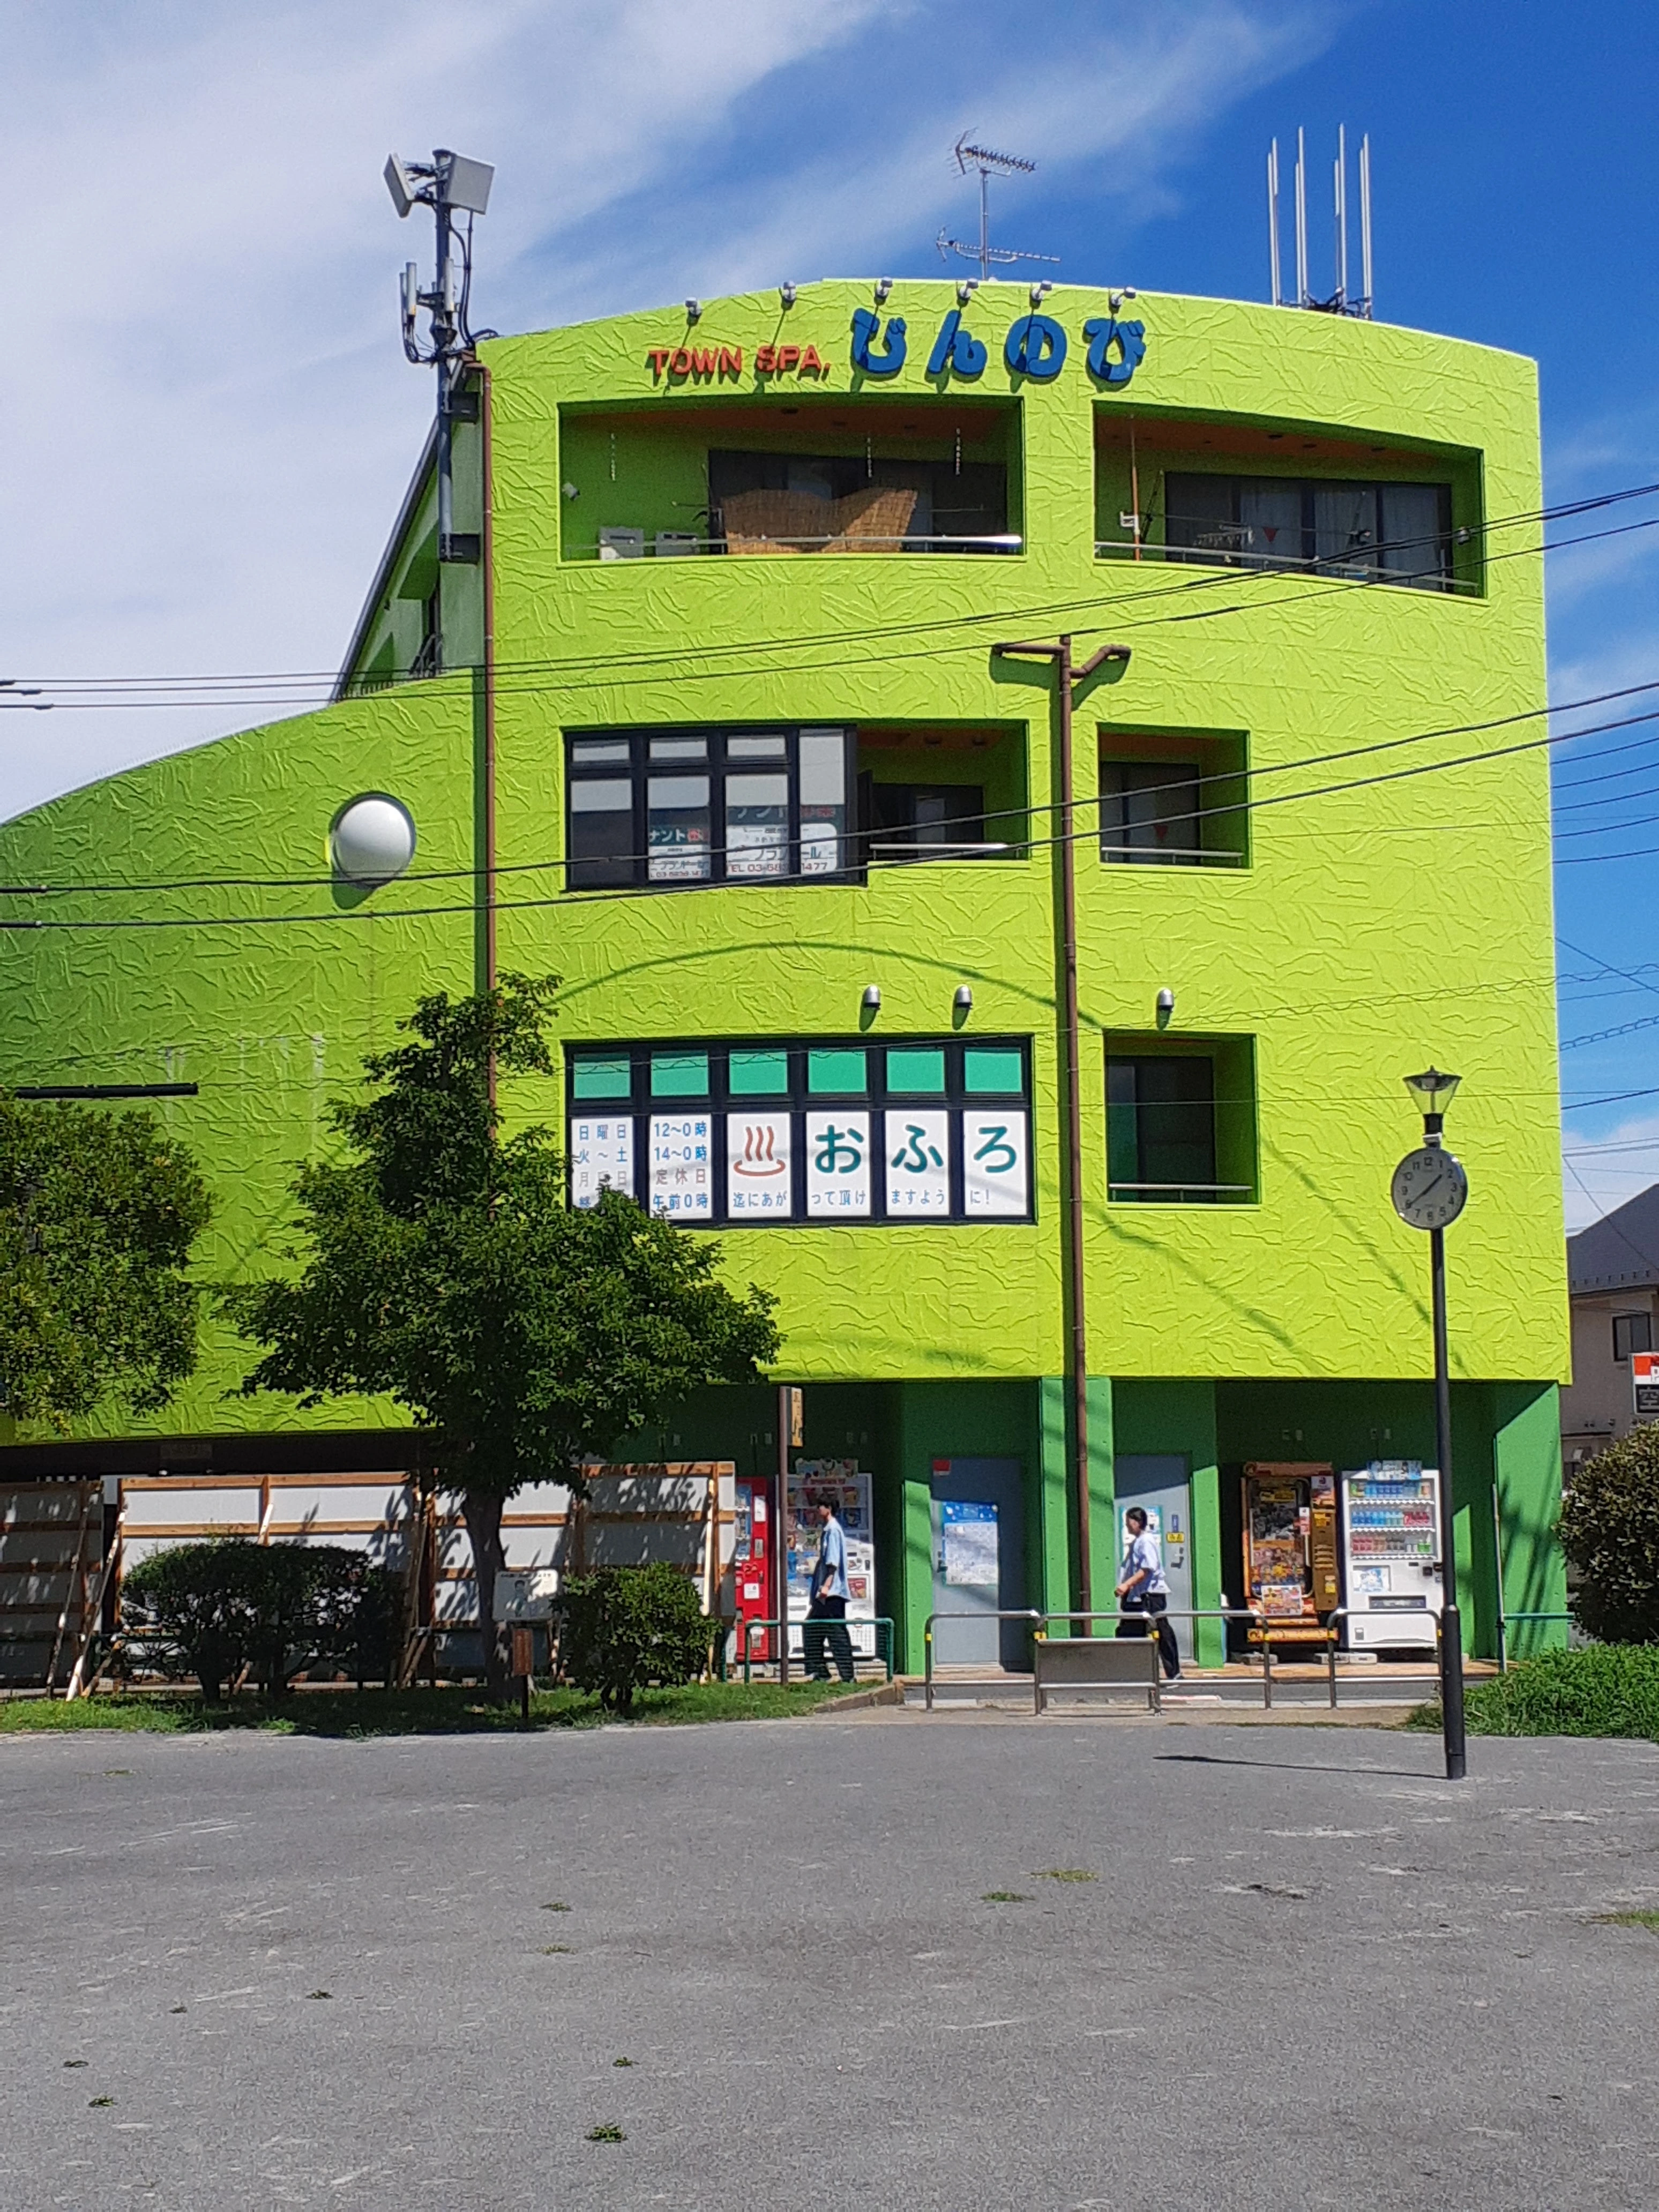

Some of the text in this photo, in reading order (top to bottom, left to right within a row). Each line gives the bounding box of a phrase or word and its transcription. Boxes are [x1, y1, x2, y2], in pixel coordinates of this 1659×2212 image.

[853, 308, 1147, 382] じんのび
[649, 346, 742, 374] TOWN
[730, 863, 745, 872] EL
[579, 1124, 626, 1140] 日曜日
[814, 1124, 1017, 1174] おふろ
[1423, 1156, 1433, 1166] 12
[1439, 1160, 1443, 1168] 1
[655, 1168, 706, 1185] 定休日
[1447, 1168, 1453, 1178] 2
[1401, 1186, 1408, 1195] 9
[1451, 1182, 1457, 1192] 3
[1448, 1195, 1454, 1205] 4
[1415, 1208, 1421, 1218] 7
[1427, 1211, 1433, 1221] 6
[1439, 1206, 1446, 1216] 5
